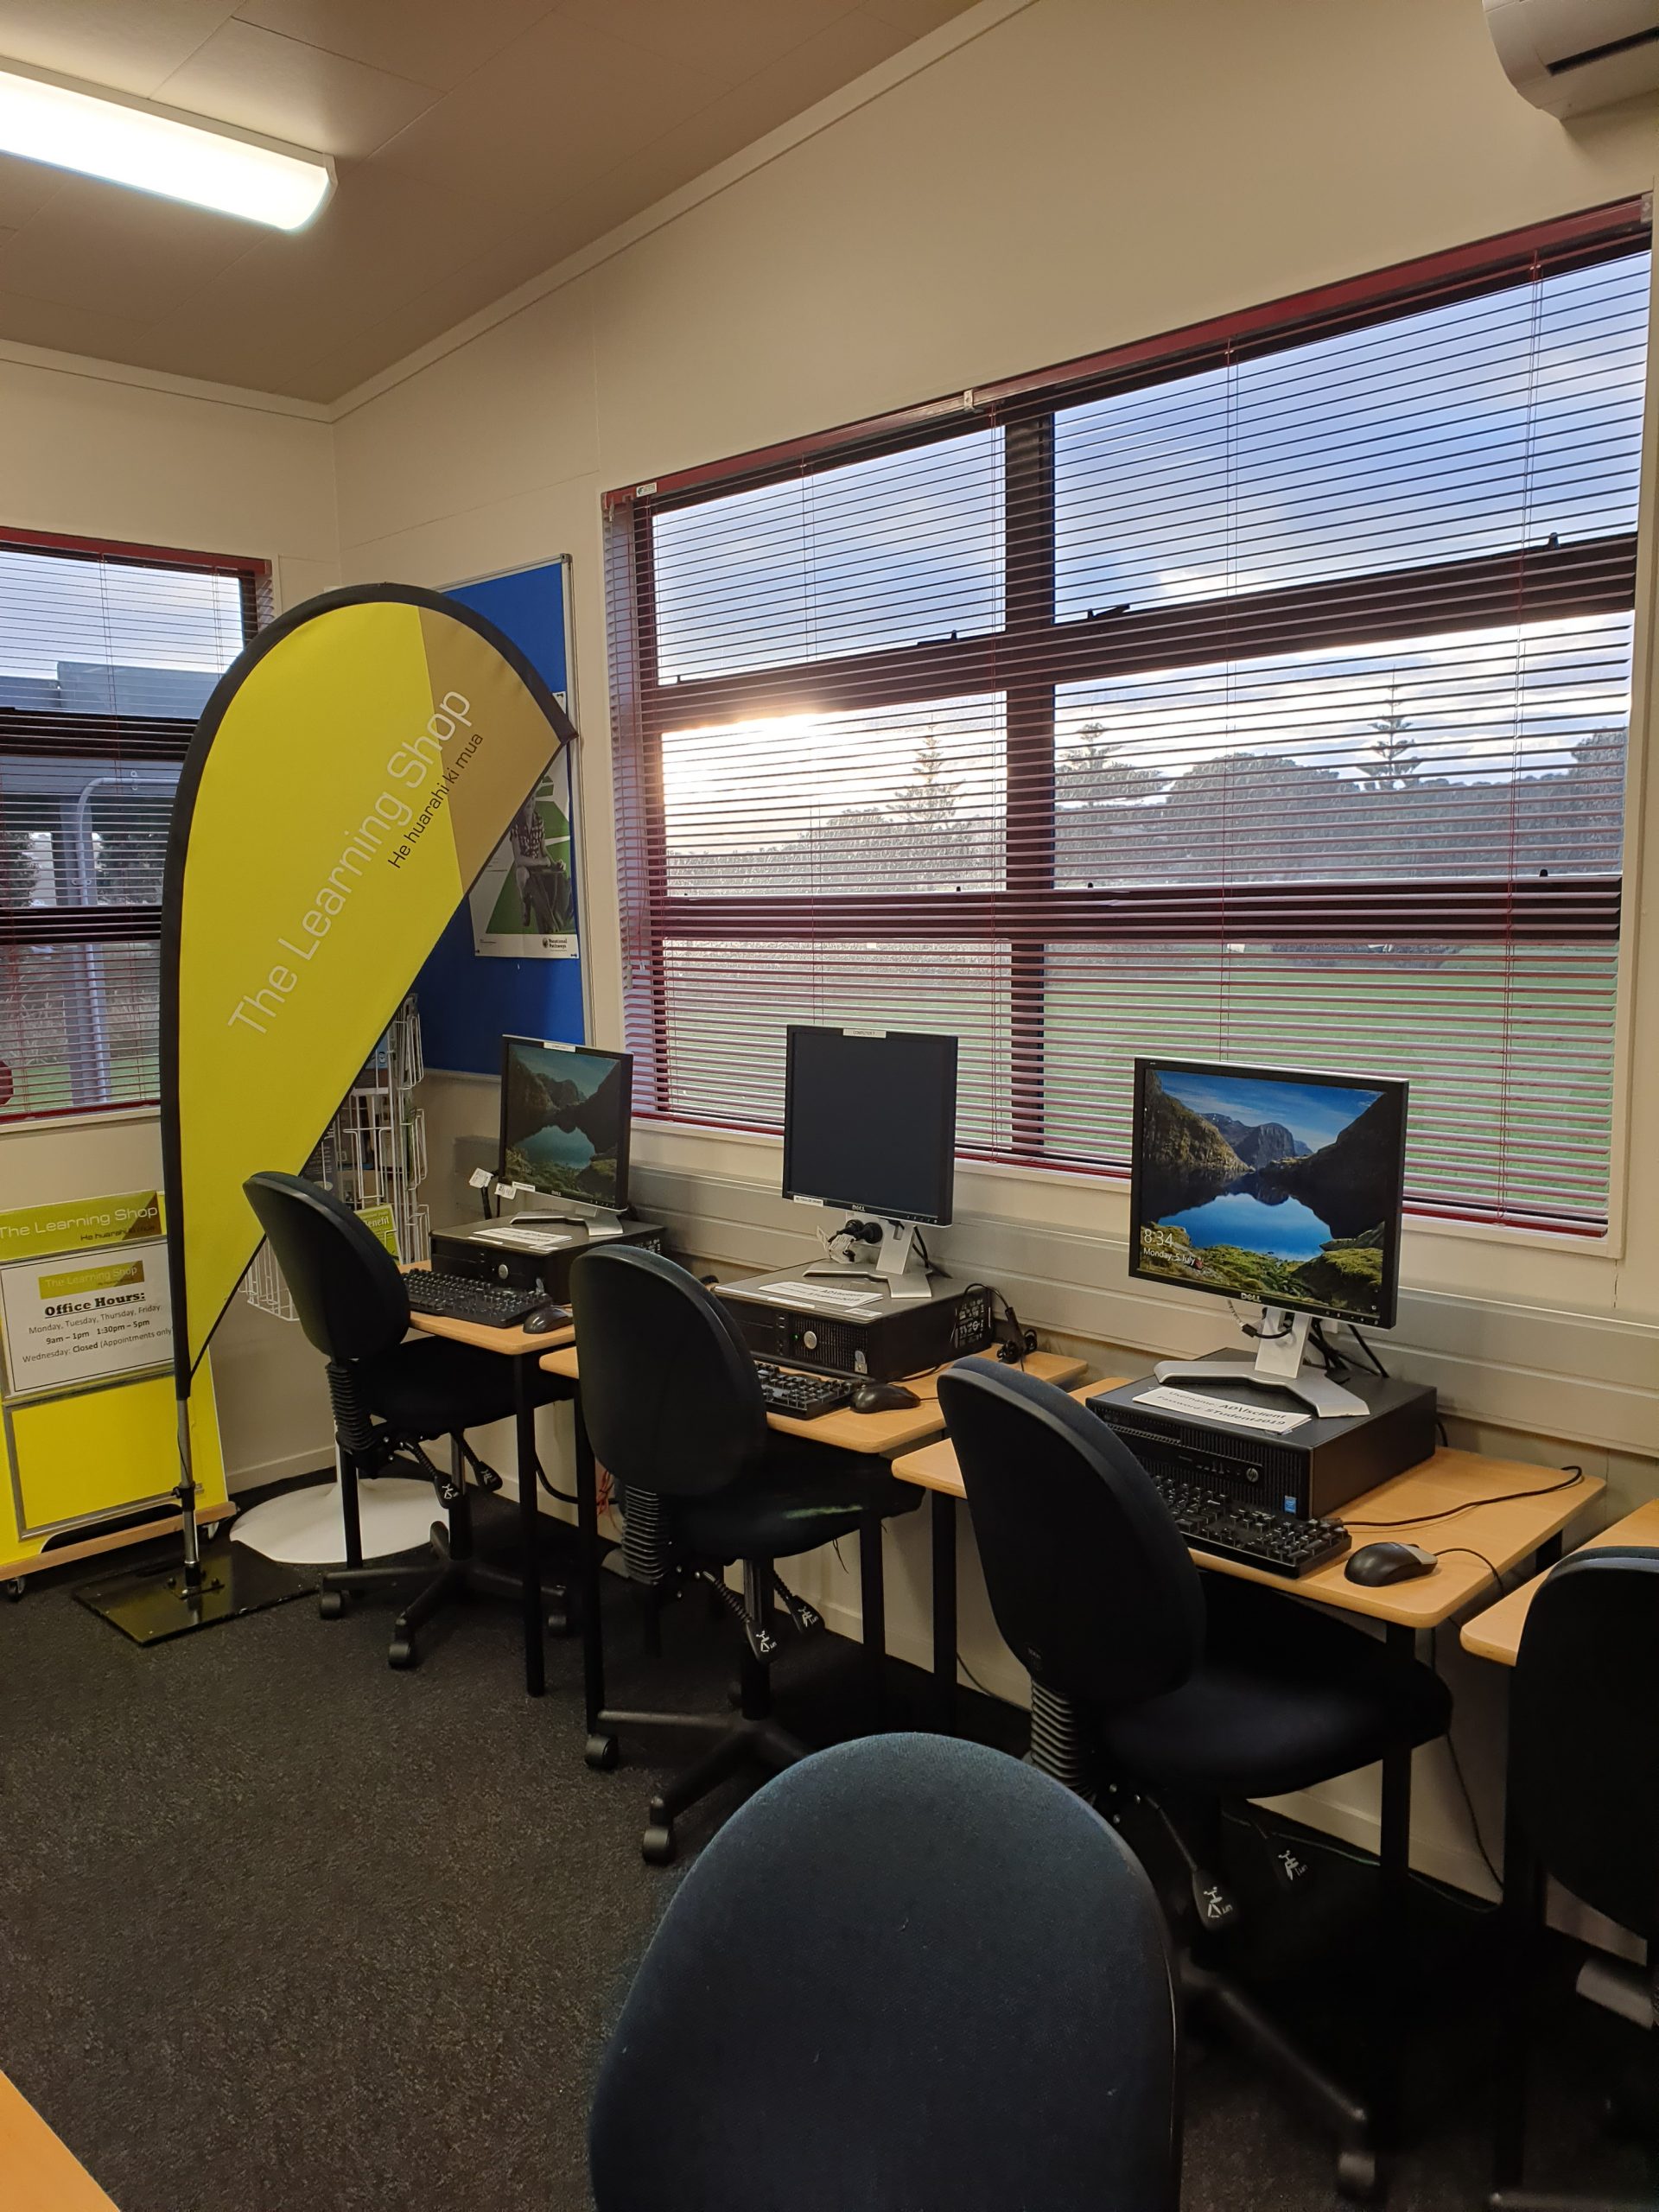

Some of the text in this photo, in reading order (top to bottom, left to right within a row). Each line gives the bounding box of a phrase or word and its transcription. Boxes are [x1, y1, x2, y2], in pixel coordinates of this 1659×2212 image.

[388, 734, 484, 868] He huarahi ki mua
[227, 691, 473, 1033] The Learning Shop
[0, 1206, 158, 1239] The Learning Shop
[1144, 1229, 1173, 1248] 8:34
[1182, 1254, 1196, 1266] July
[45, 1279, 63, 1287] The
[67, 1271, 111, 1285] Learning
[113, 1267, 137, 1277] Shop
[45, 1292, 145, 1317] Office Hours:
[138, 1304, 161, 1314] Friday
[1240, 1292, 1262, 1303] DELL
[46, 1336, 64, 1344] 9am
[73, 1331, 90, 1340] 1pm
[97, 1324, 125, 1336] 1:30pm
[132, 1319, 150, 1330] 5pm
[22, 1349, 71, 1363] Wednesday:
[73, 1342, 99, 1353] Closed
[100, 1331, 156, 1349] (Appointments
